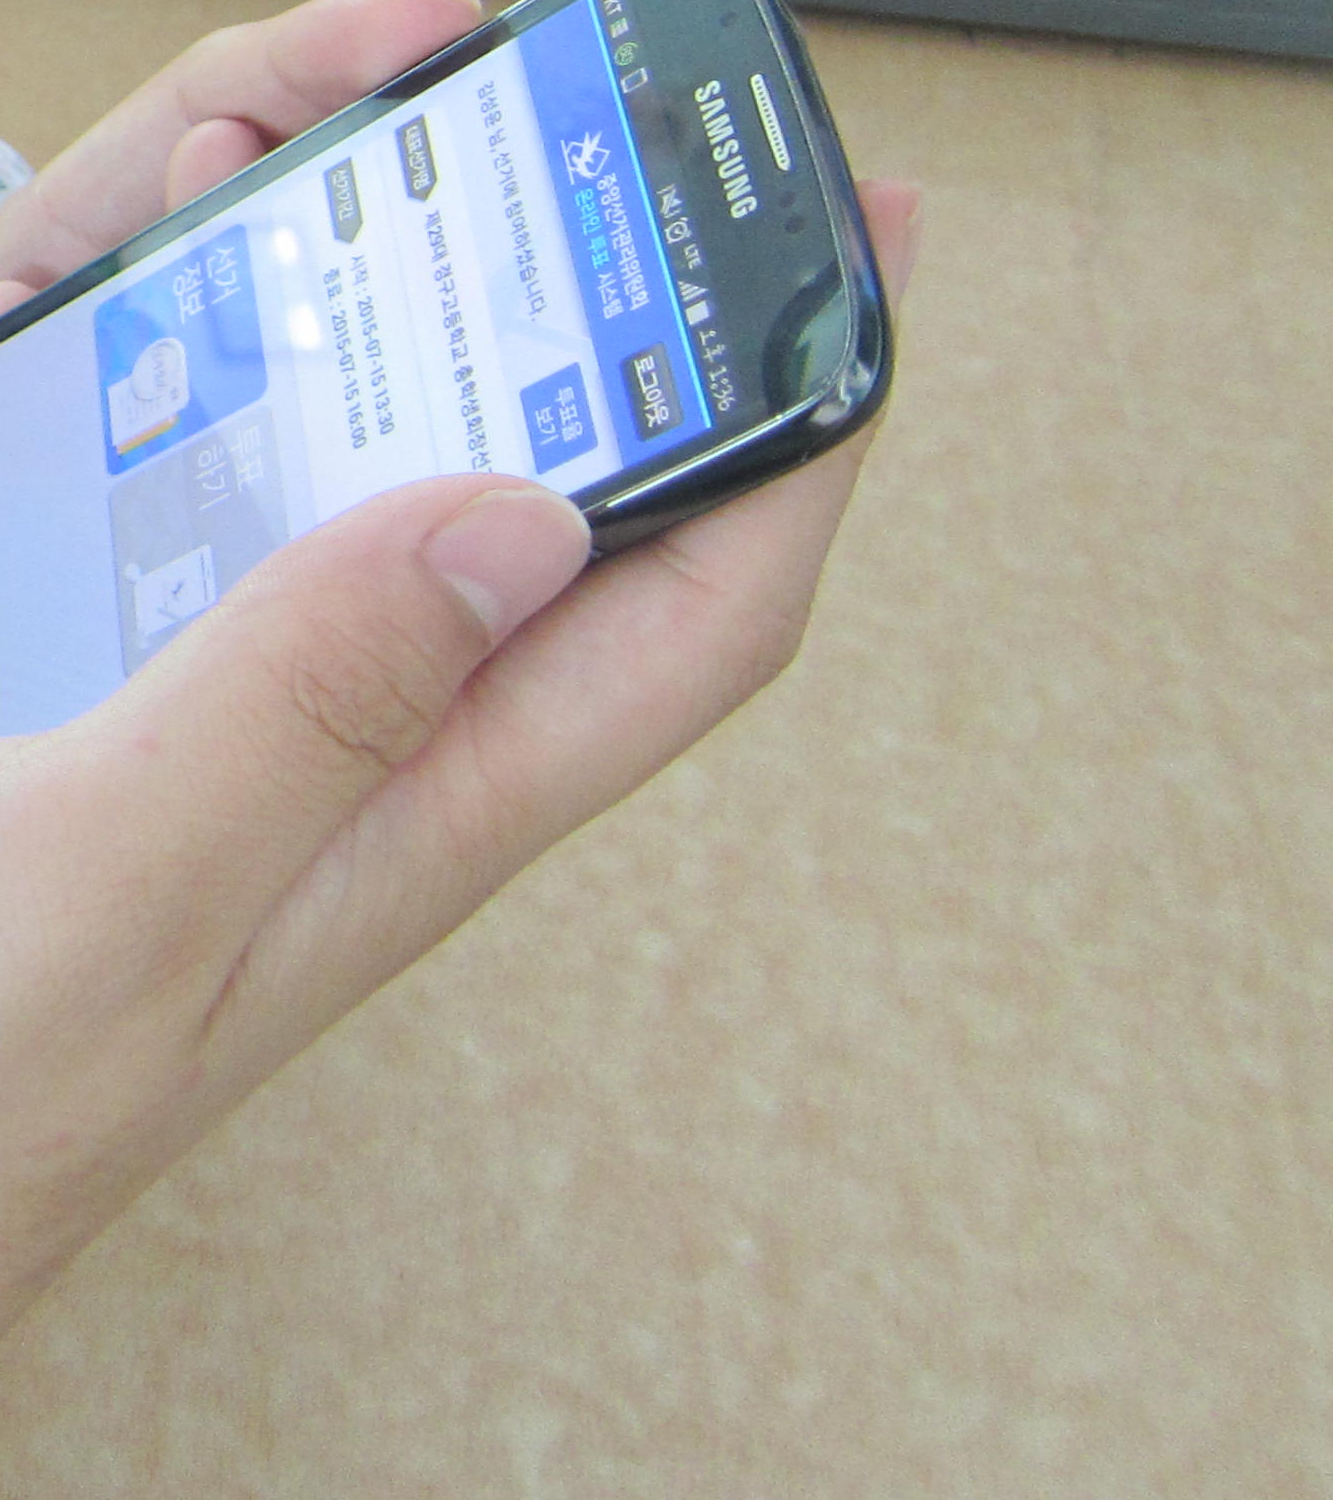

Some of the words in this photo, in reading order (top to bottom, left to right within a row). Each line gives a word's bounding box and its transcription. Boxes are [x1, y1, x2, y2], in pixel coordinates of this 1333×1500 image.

[494, 152, 519, 200] 선거에
[694, 81, 757, 219] SAMSUNG
[332, 168, 356, 222] 선거기간
[575, 189, 601, 231] 온라인
[425, 209, 448, 263] 제29대
[586, 234, 609, 270] 투표
[597, 172, 649, 312] 중앙선거관리위원회
[684, 244, 701, 269] LTE
[173, 261, 206, 324] 정보
[206, 246, 240, 304] 선거
[323, 267, 342, 301] 종료
[350, 255, 369, 286] 시작
[597, 275, 624, 320] 시스템
[433, 264, 470, 364] 경구고등학교
[331, 310, 360, 401] 2015-07-15
[357, 296, 386, 387] 2015-07-15
[699, 329, 725, 363] 오후
[374, 388, 395, 435] 13:30
[554, 386, 583, 443] 투표율
[634, 355, 669, 428] 로그아웃
[711, 366, 735, 412] 1:36
[347, 402, 367, 450] 16:00
[454, 365, 492, 473] 총학생회장선
[536, 408, 559, 447] 보기
[197, 445, 230, 510] 하기
[230, 424, 265, 492] 투표
